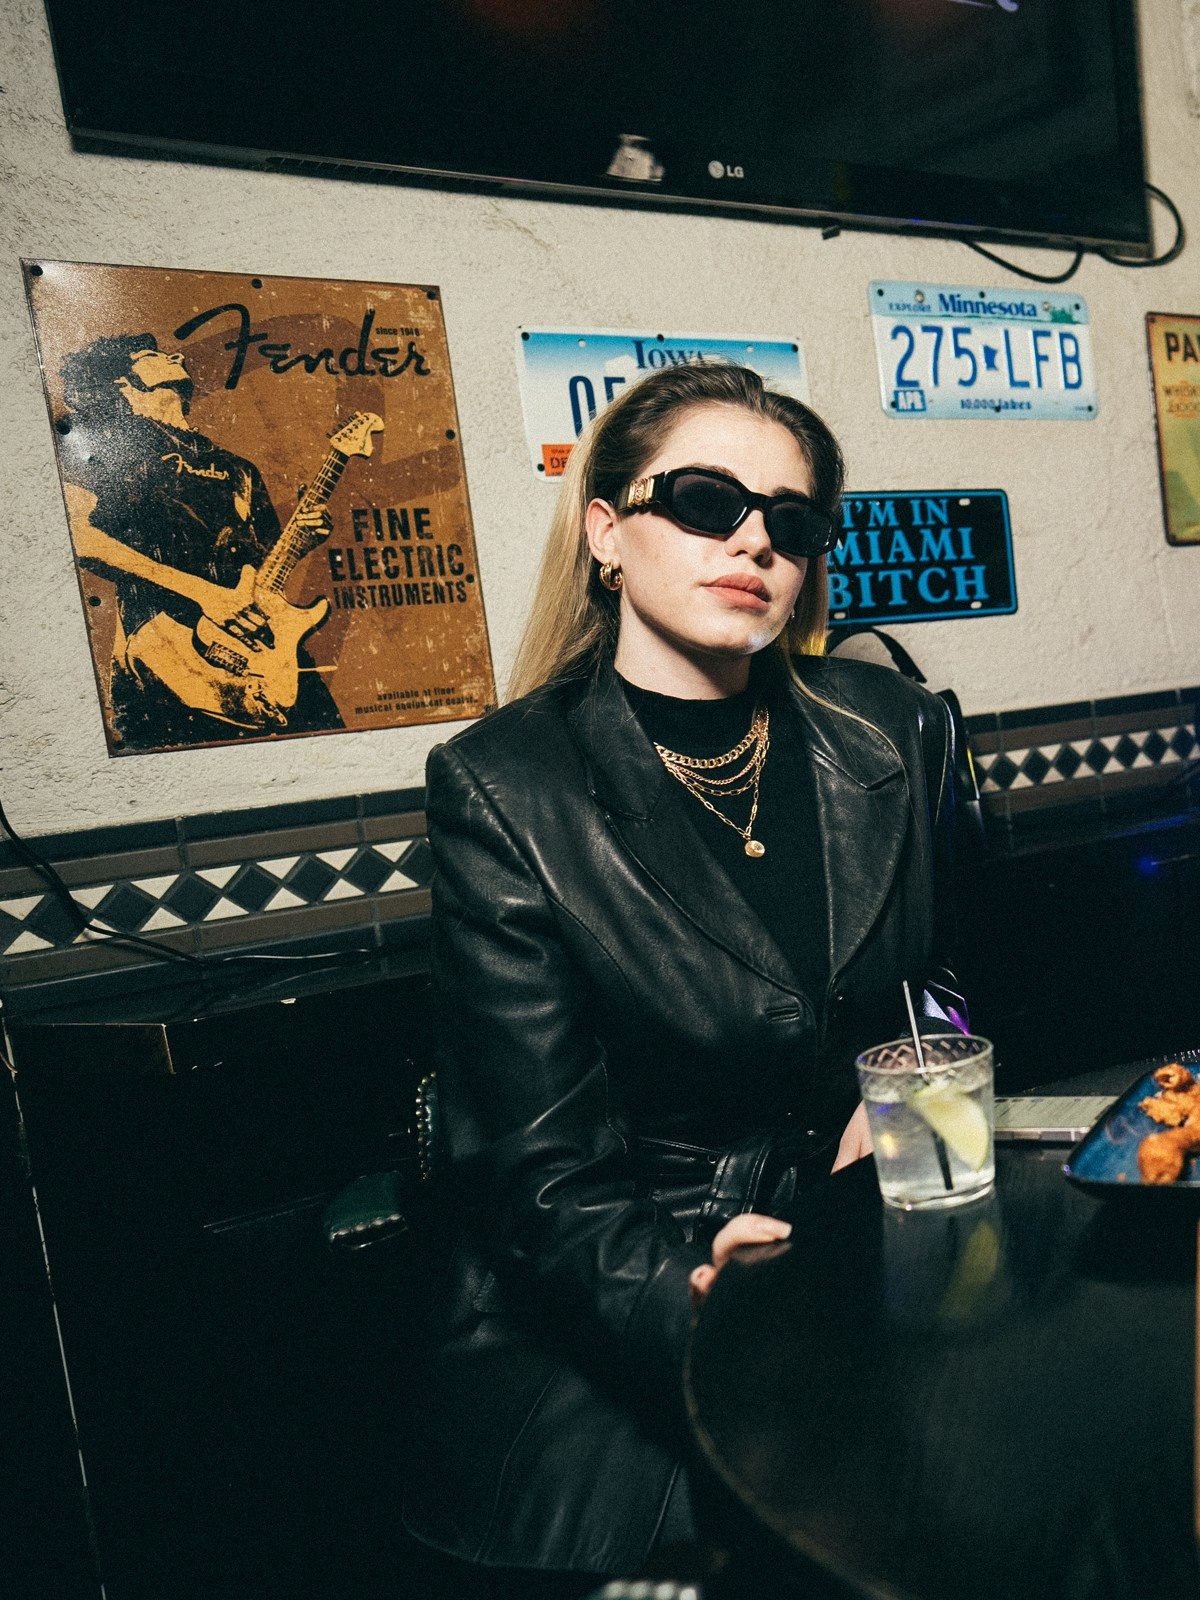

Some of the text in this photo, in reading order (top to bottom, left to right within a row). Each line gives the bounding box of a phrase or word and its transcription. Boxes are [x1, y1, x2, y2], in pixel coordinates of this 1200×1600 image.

[726, 165, 744, 178] LG
[938, 293, 1037, 317] Minnesota
[173, 303, 431, 390] Fender
[632, 340, 706, 370] Iow
[891, 325, 1083, 390] 275 LFB
[161, 452, 230, 481] Fender
[352, 508, 434, 542] FINE
[841, 499, 949, 528] I'M IN
[827, 527, 976, 567] MIAMI
[327, 543, 465, 582] ELECTRIC
[332, 580, 467, 609] INSTRUMENTS
[828, 565, 990, 610] BITCH
[355, 704, 392, 714] musical
